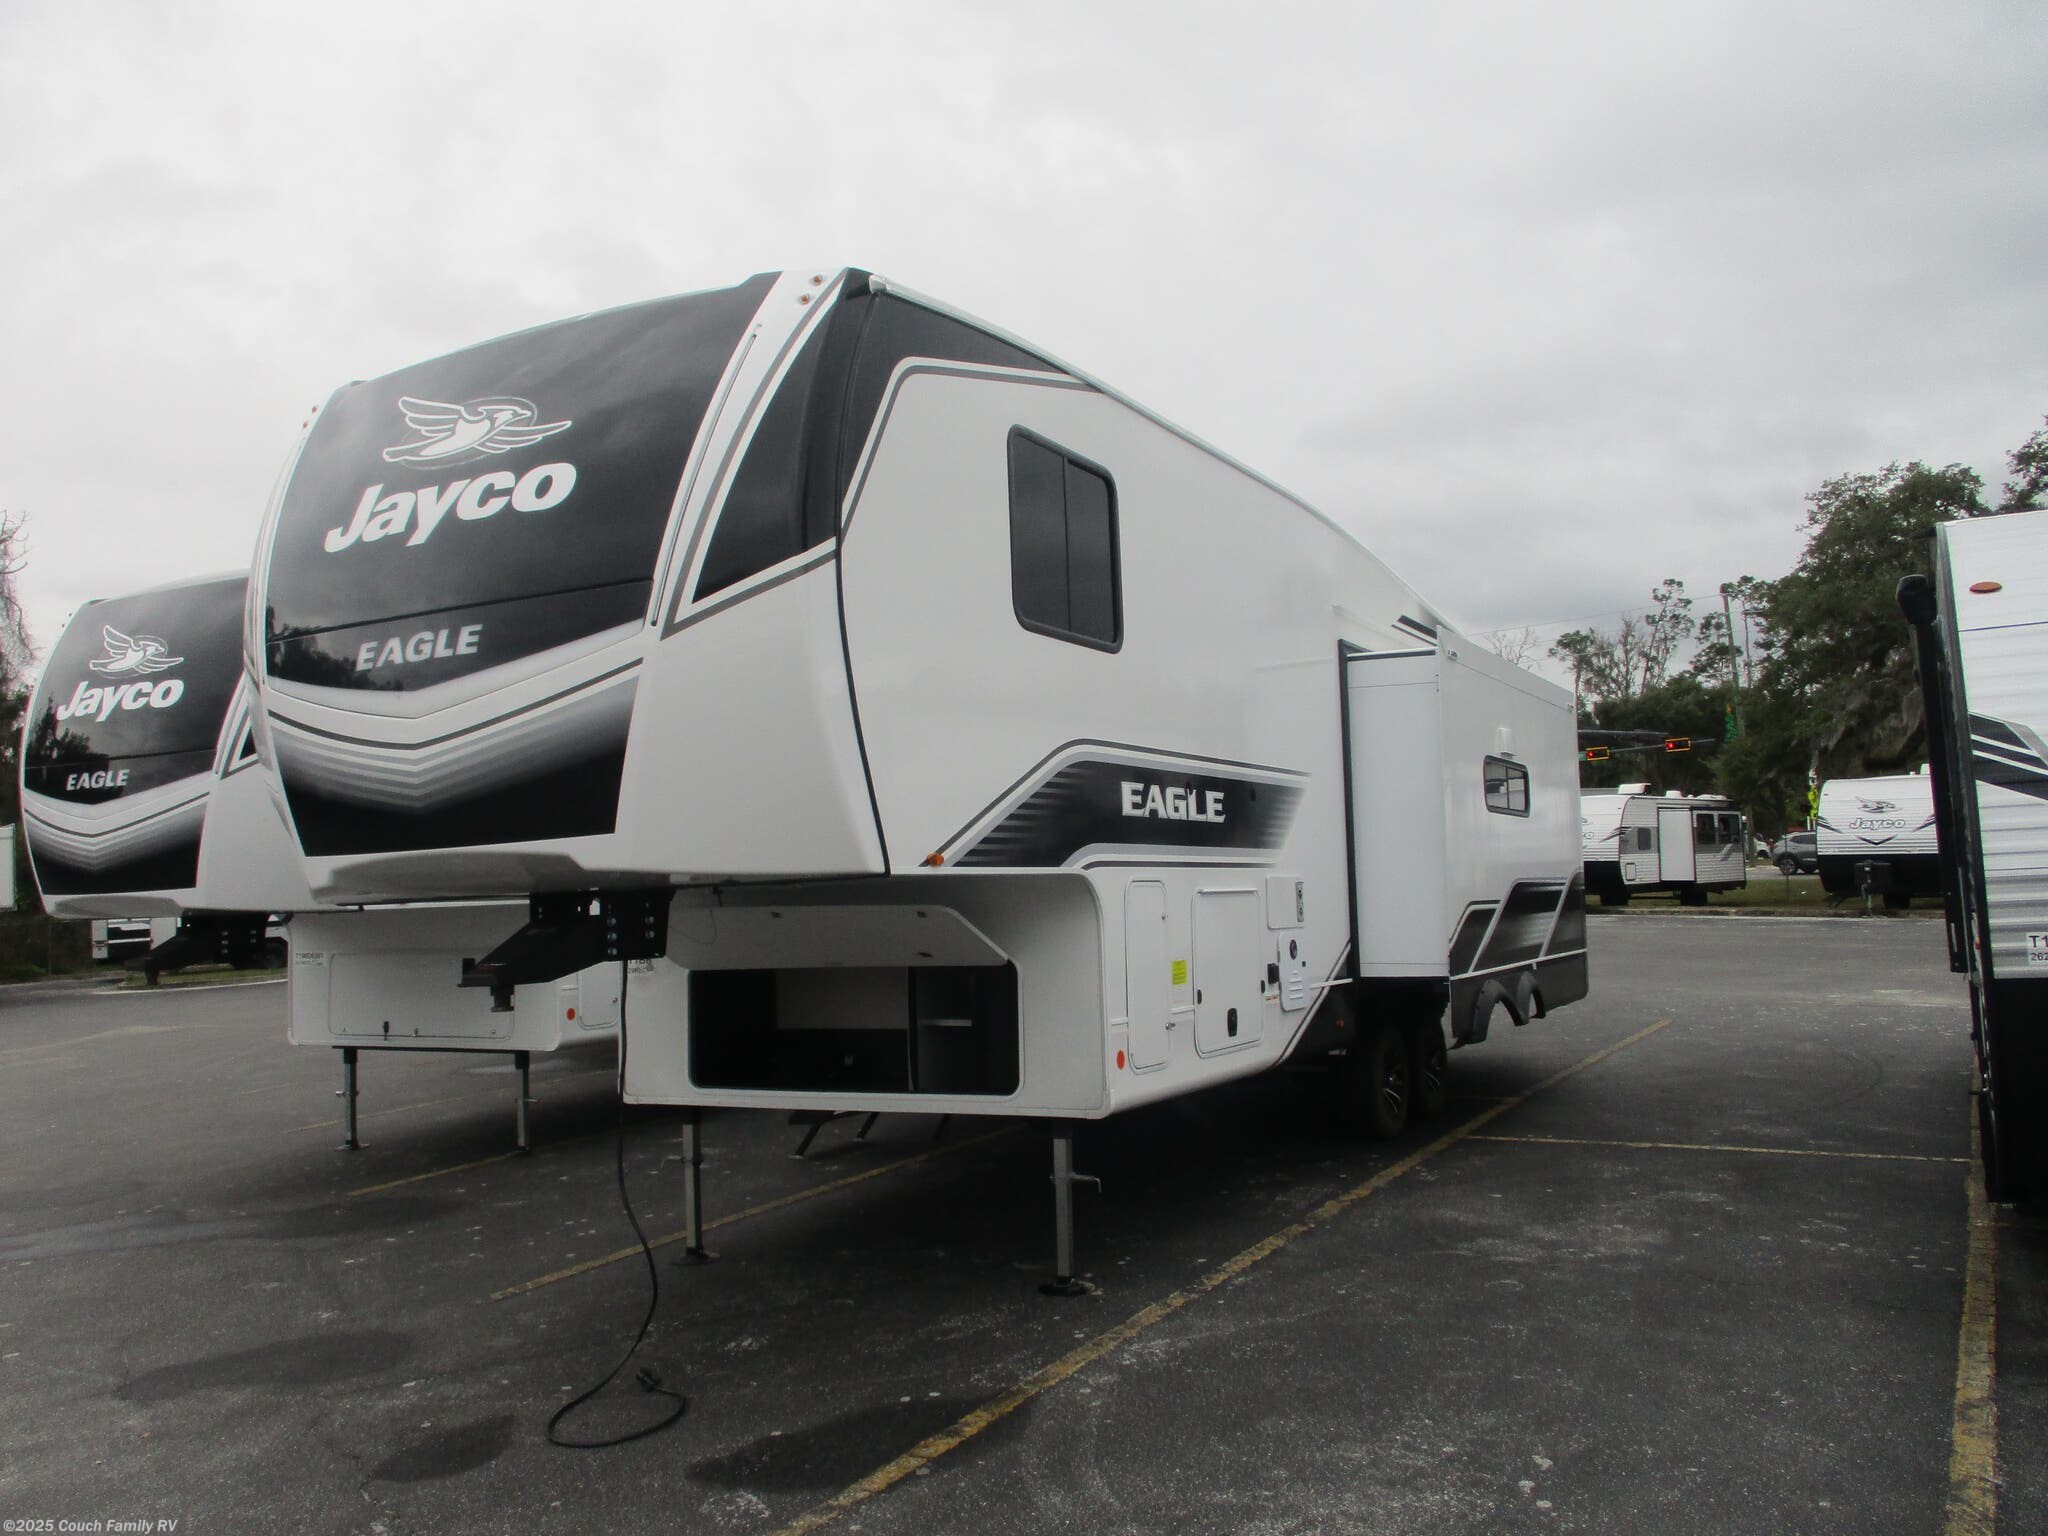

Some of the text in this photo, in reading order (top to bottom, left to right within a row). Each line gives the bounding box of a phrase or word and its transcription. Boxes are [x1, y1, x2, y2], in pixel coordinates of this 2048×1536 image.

[324, 462, 577, 553] Jayco
[355, 623, 484, 672] EAGLE
[55, 679, 185, 723] Jayco
[65, 768, 131, 792] EAGLE
[1120, 780, 1226, 824] EAGLE
[1848, 817, 1906, 831] Jayco
